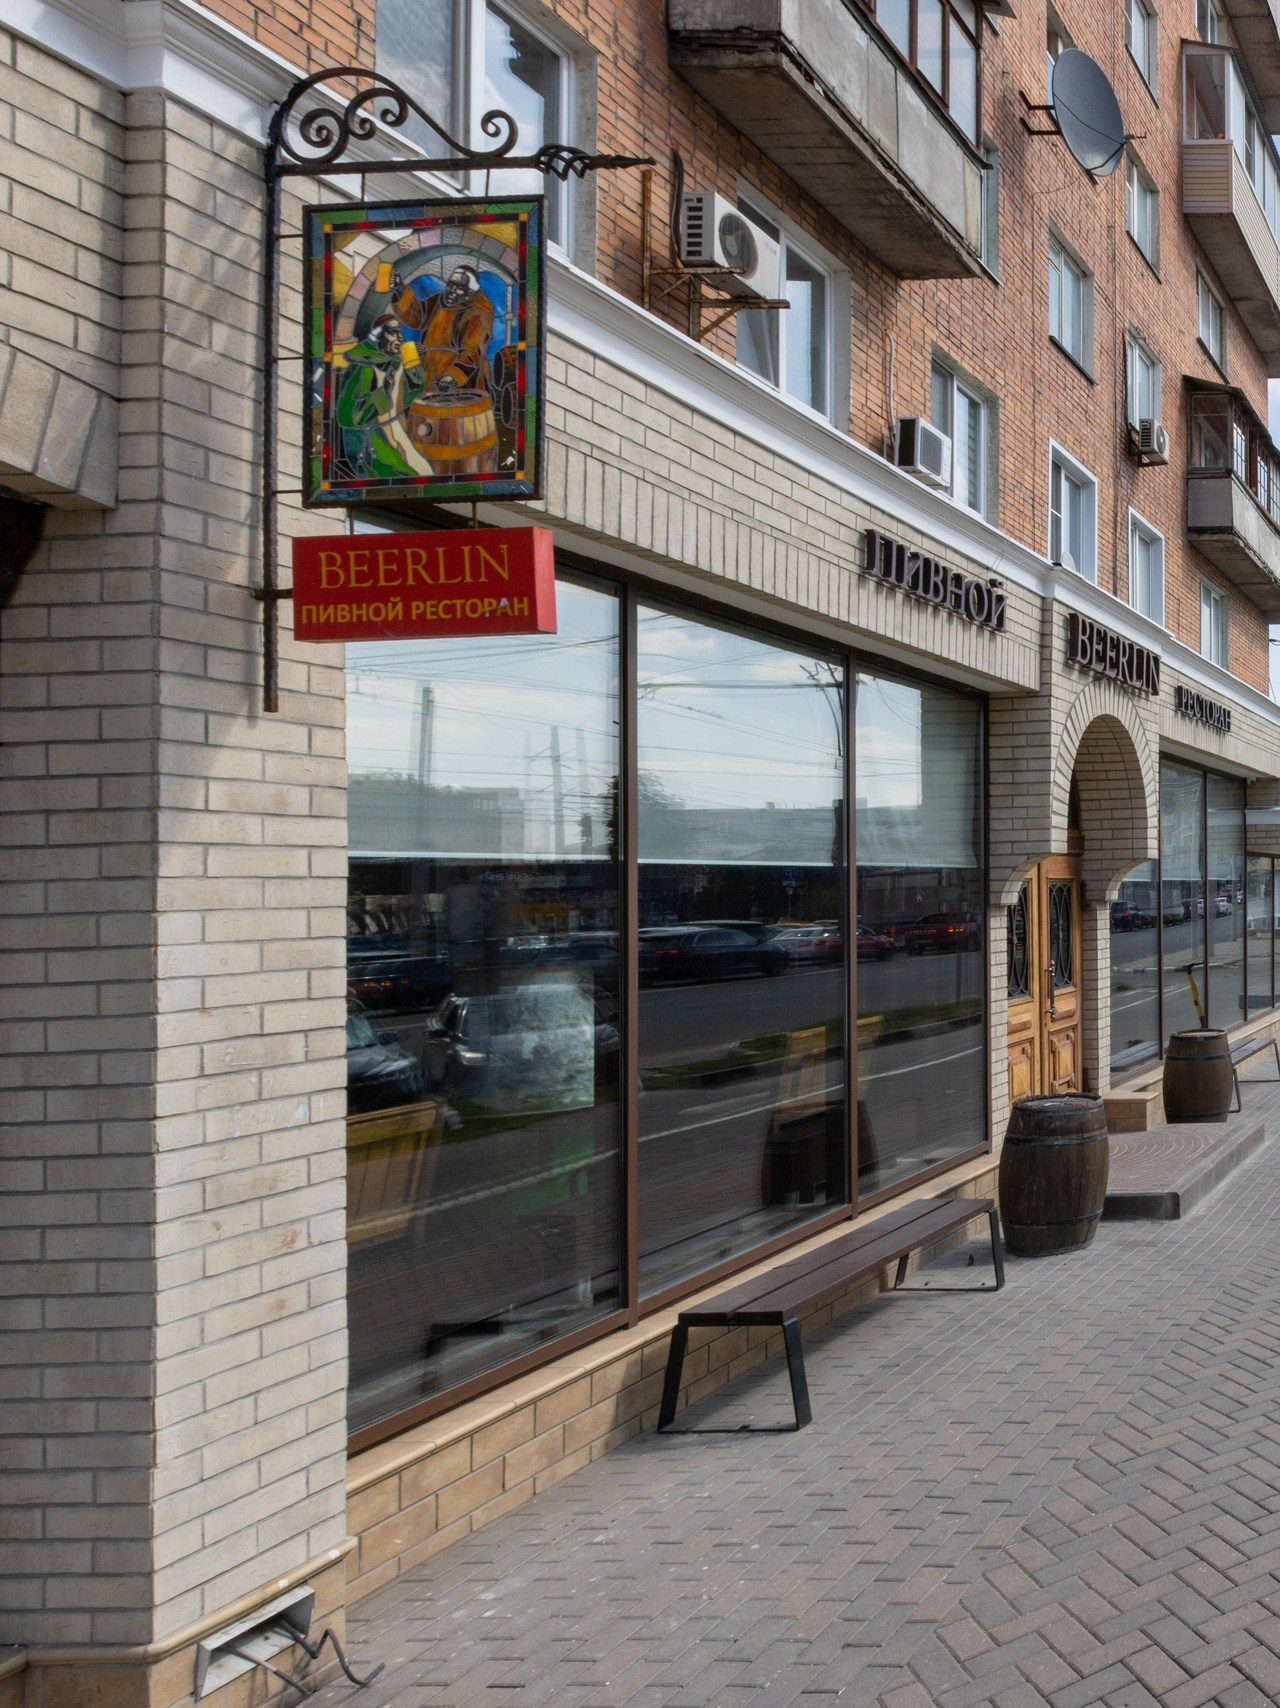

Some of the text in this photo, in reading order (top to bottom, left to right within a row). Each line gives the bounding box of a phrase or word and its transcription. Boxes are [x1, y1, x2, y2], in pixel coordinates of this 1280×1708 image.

[317, 544, 509, 589] BEERLIN
[863, 529, 1009, 633] ПИВНОЙ
[302, 596, 529, 624] ПИВНОЙ РЕСТОРАН
[1067, 612, 1161, 696] BEERLIN
[1176, 684, 1232, 733] РЕСТОРАН
